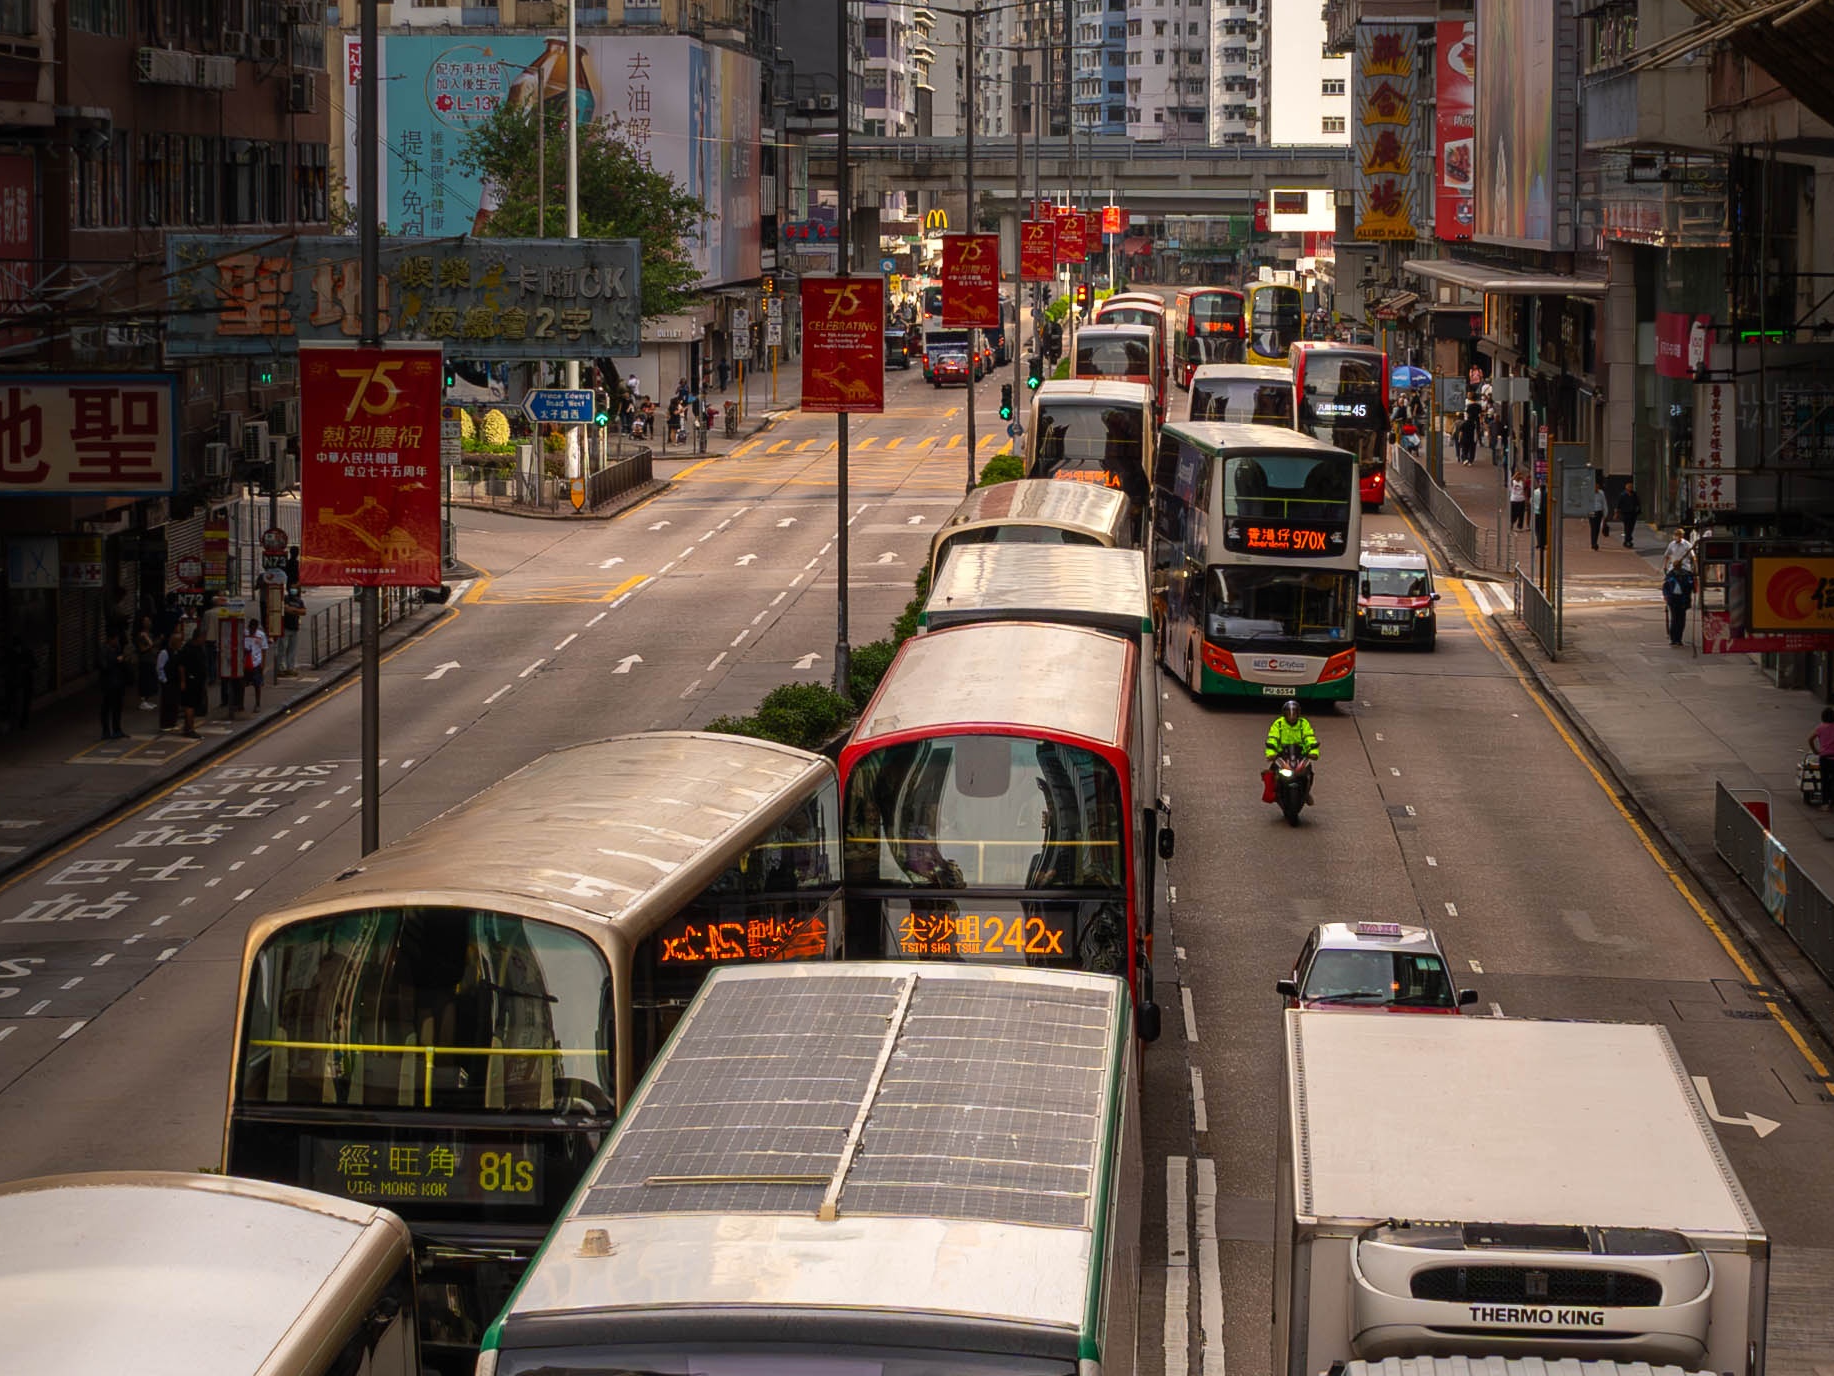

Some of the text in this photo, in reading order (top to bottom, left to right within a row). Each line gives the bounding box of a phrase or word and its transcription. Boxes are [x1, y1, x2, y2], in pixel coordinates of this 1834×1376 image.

[435, 78, 501, 91] 加入後生元
[1387, 230, 1416, 239] PLAZA
[956, 239, 983, 264] 75
[214, 255, 391, 339] 聖地
[823, 284, 862, 320] 75
[808, 321, 877, 332] CELEBRATING
[335, 360, 404, 422] 75
[564, 392, 591, 400] Edward
[1352, 404, 1367, 417] 45
[321, 425, 424, 450] 熱烈慶祝
[316, 452, 399, 465] 中華人民共和國
[344, 465, 429, 479] 成立七十五周年
[1292, 532, 1327, 551] 970X
[177, 593, 205, 607] N72
[213, 761, 340, 779] BUS
[144, 798, 282, 821] 巴士
[114, 825, 235, 849] 站
[43, 856, 205, 886] 巴士
[1, 891, 140, 924] 站
[898, 912, 1064, 955] 尖沙咀 242x
[901, 942, 981, 954] TSIM SHA TSUI
[387, 1144, 455, 1179] 旺角
[346, 1181, 449, 1196] VIA: MONG KOK
[1469, 1306, 1605, 1327] THERMO KING
